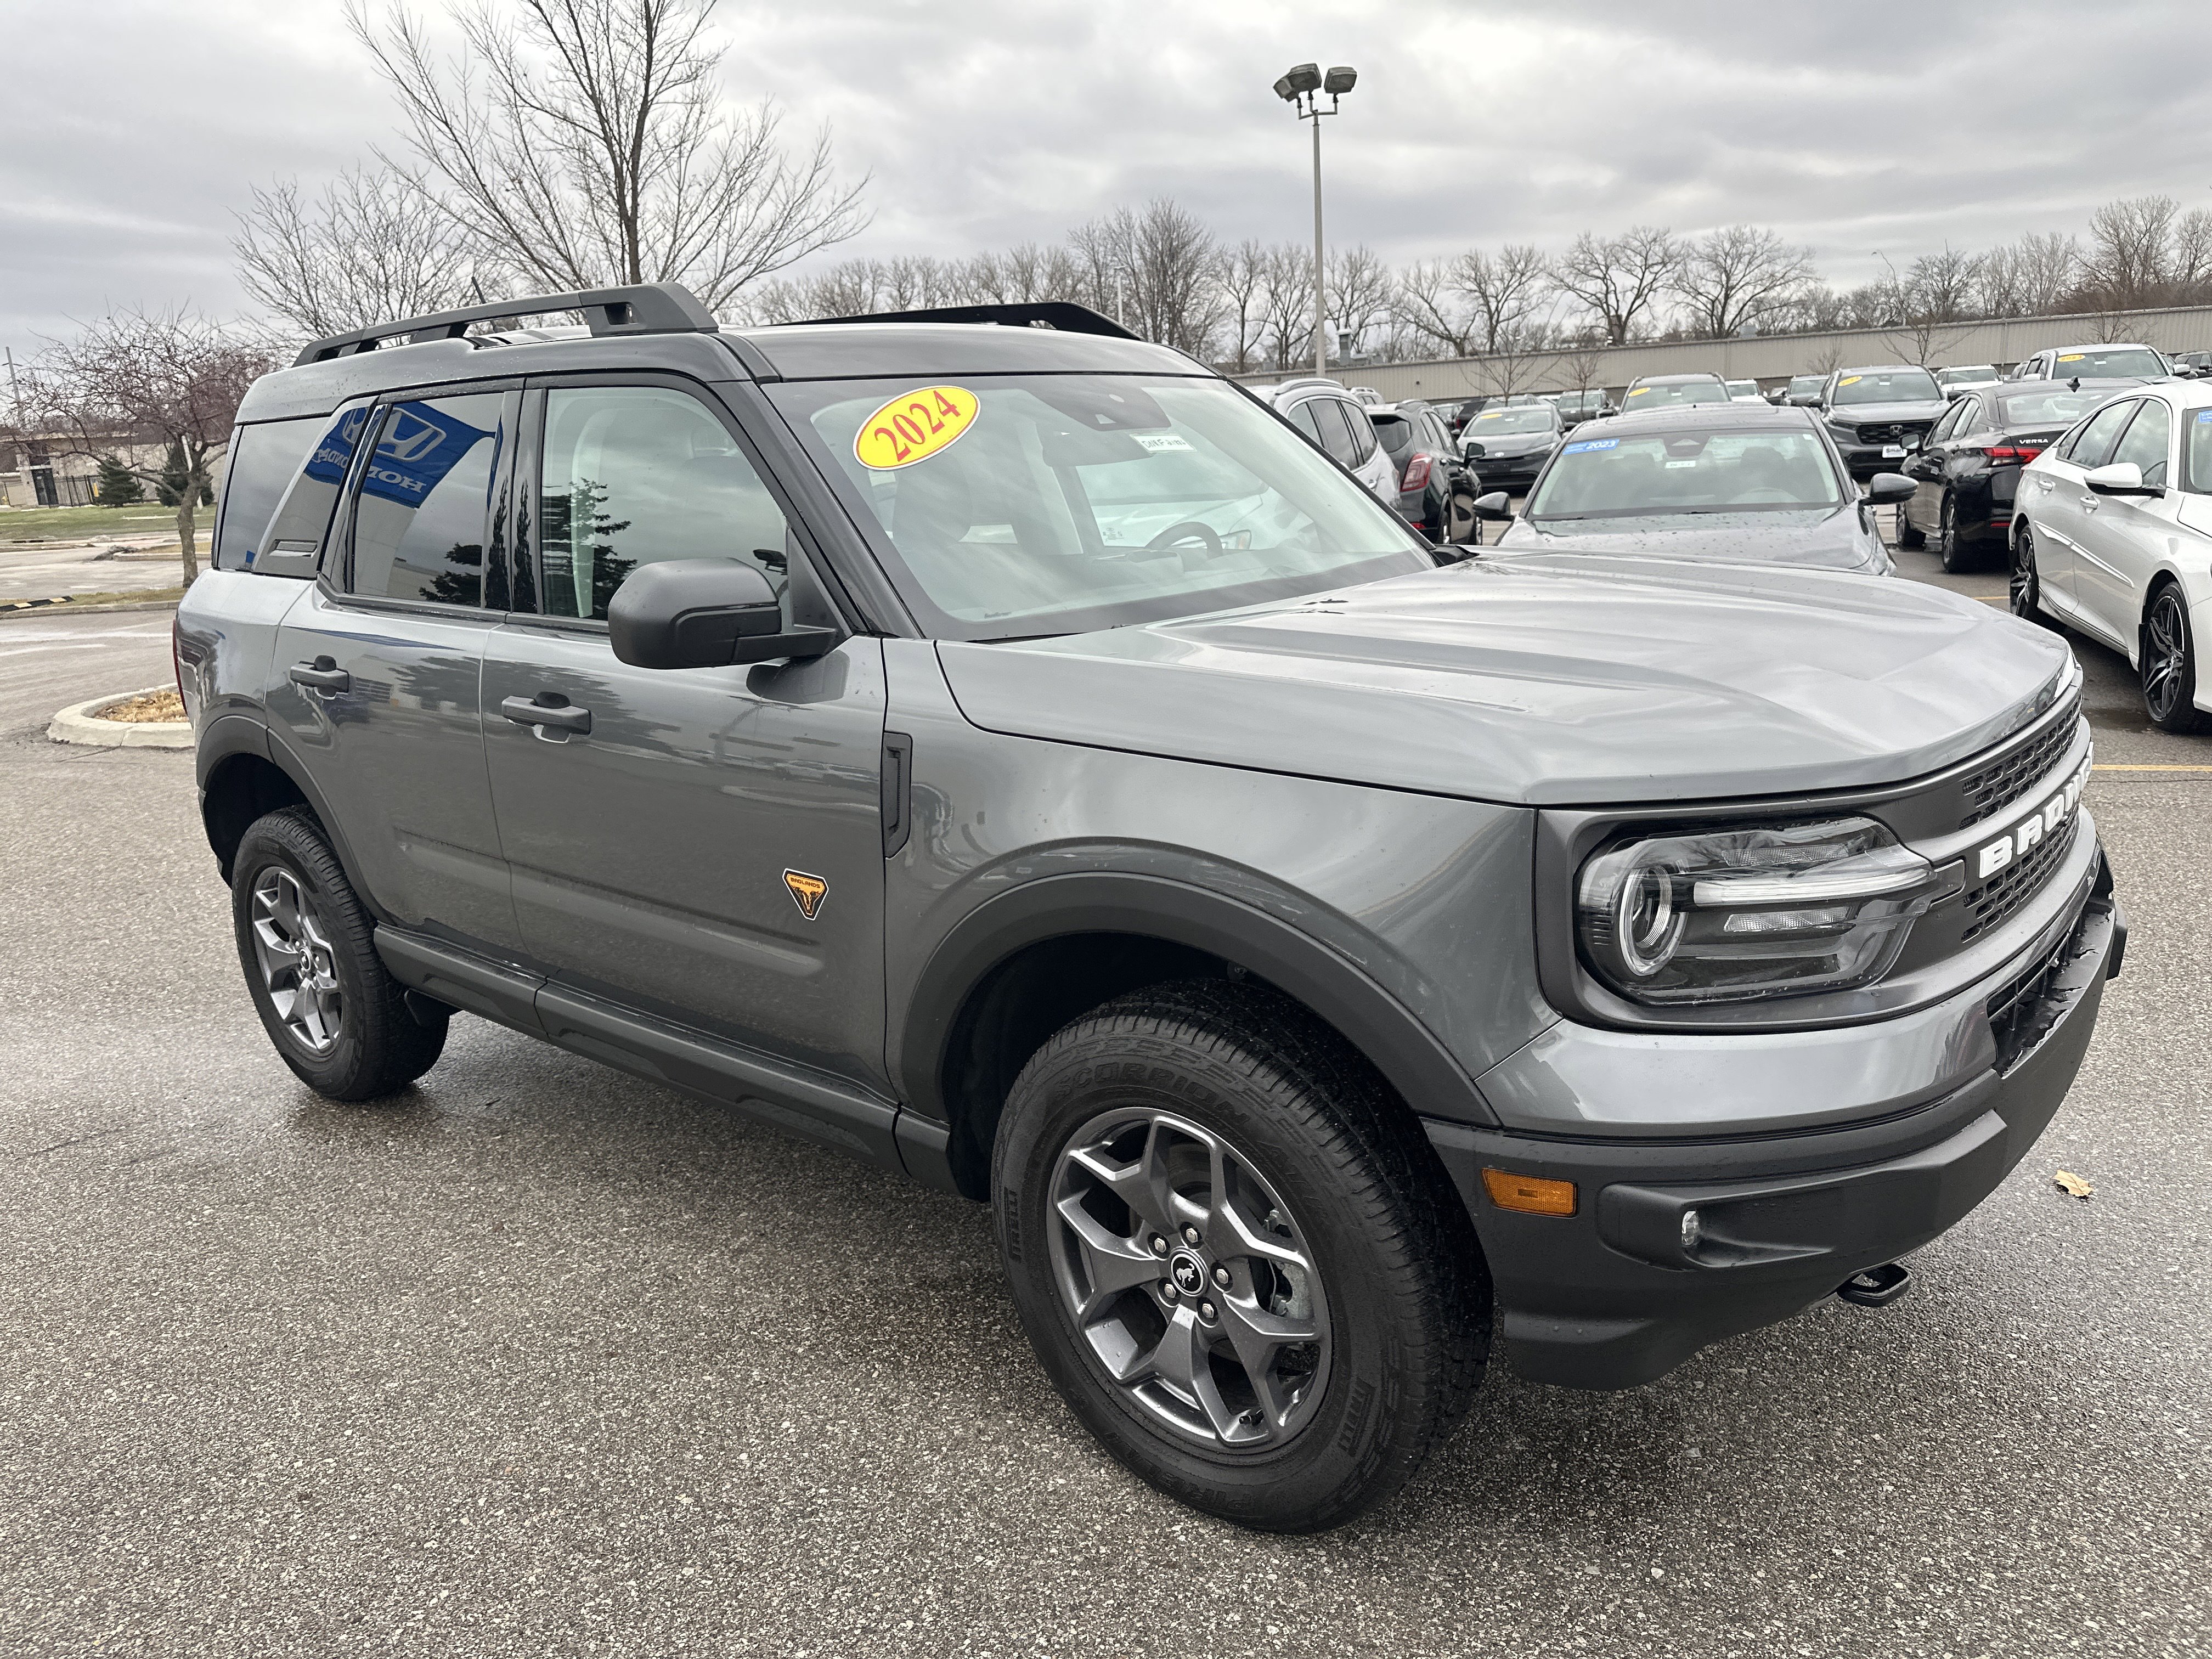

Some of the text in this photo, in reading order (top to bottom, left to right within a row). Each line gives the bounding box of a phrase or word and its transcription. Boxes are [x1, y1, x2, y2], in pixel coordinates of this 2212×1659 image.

[874, 390, 961, 462] 2024
[1586, 440, 1616, 449] 2023
[790, 877, 821, 889] BADLANDS
[1054, 1061, 1251, 1126] SCORPION
